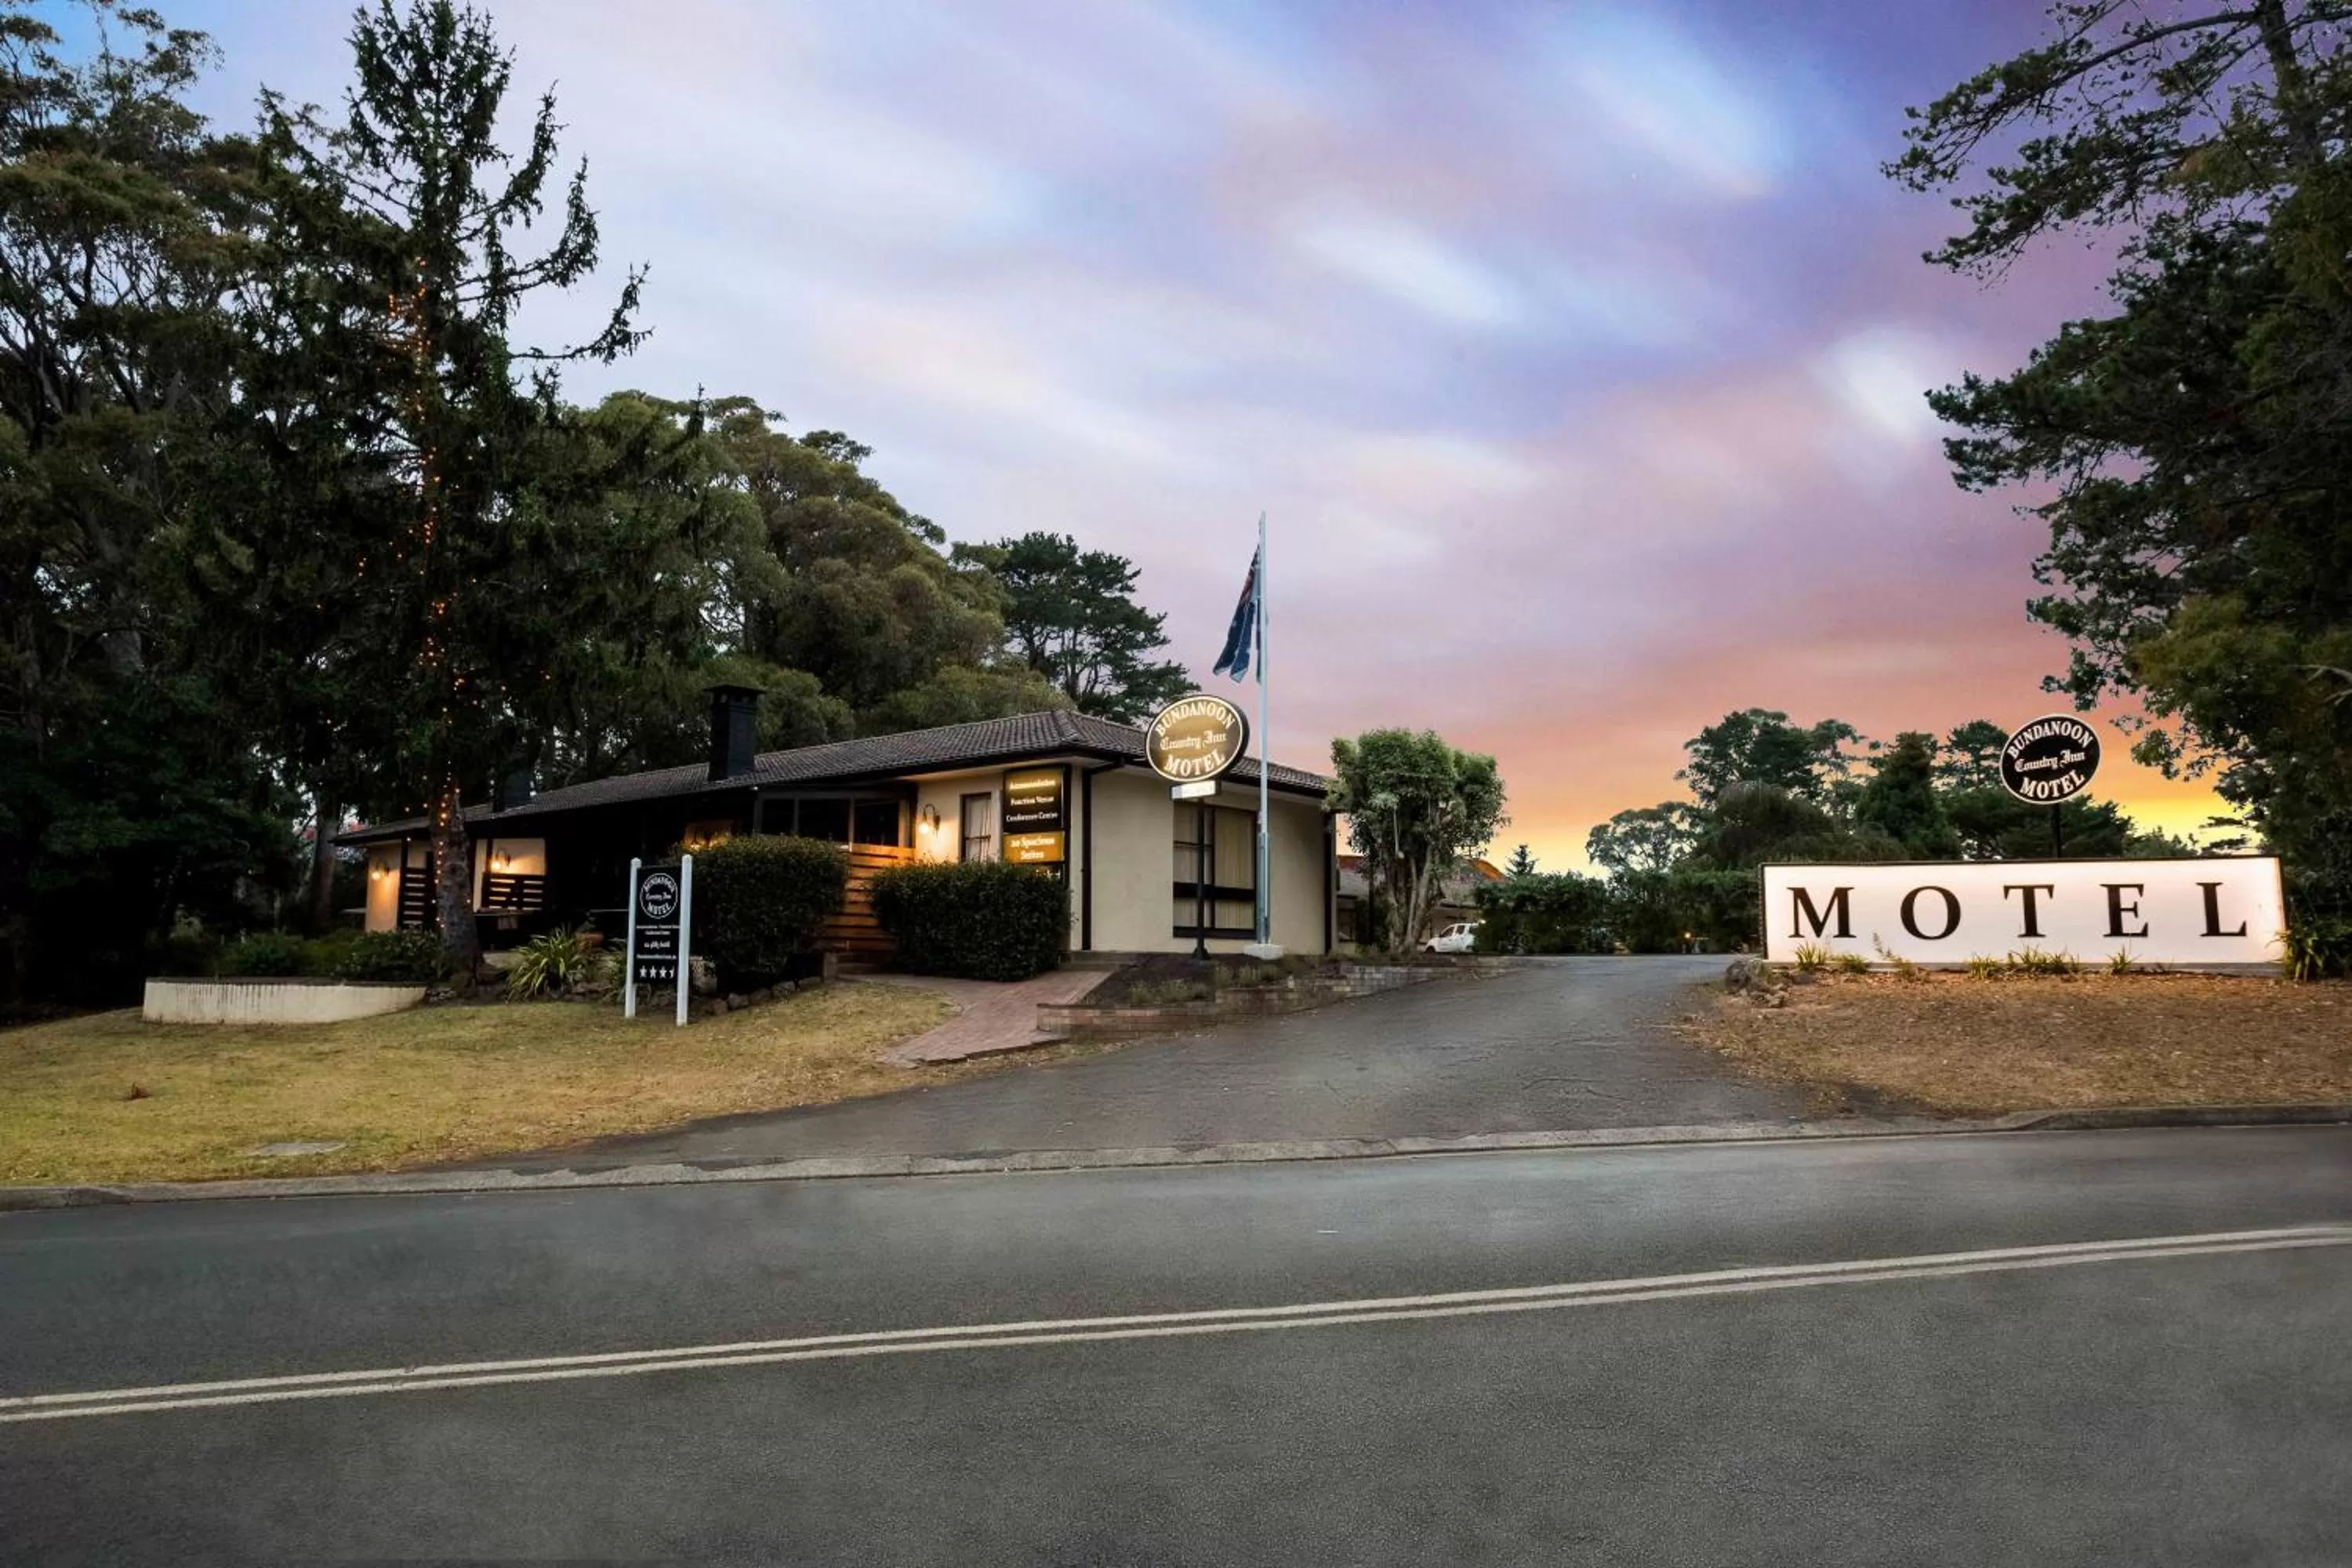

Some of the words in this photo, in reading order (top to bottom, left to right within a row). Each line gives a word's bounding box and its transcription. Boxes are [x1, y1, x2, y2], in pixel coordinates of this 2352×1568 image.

[1156, 702, 1236, 737] BUNDANOON
[1160, 736, 1201, 750] Country
[1202, 730, 1227, 746] Inn
[2007, 720, 2093, 759] BUNDANOON
[1163, 749, 1225, 777] MOTEL
[2014, 755, 2058, 772] Country
[2060, 749, 2085, 768] Inn
[2019, 769, 2085, 799] MOTEL
[1011, 797, 1035, 806] Function
[648, 902, 672, 915] MOTEL
[1788, 882, 2247, 939] MOTEL
